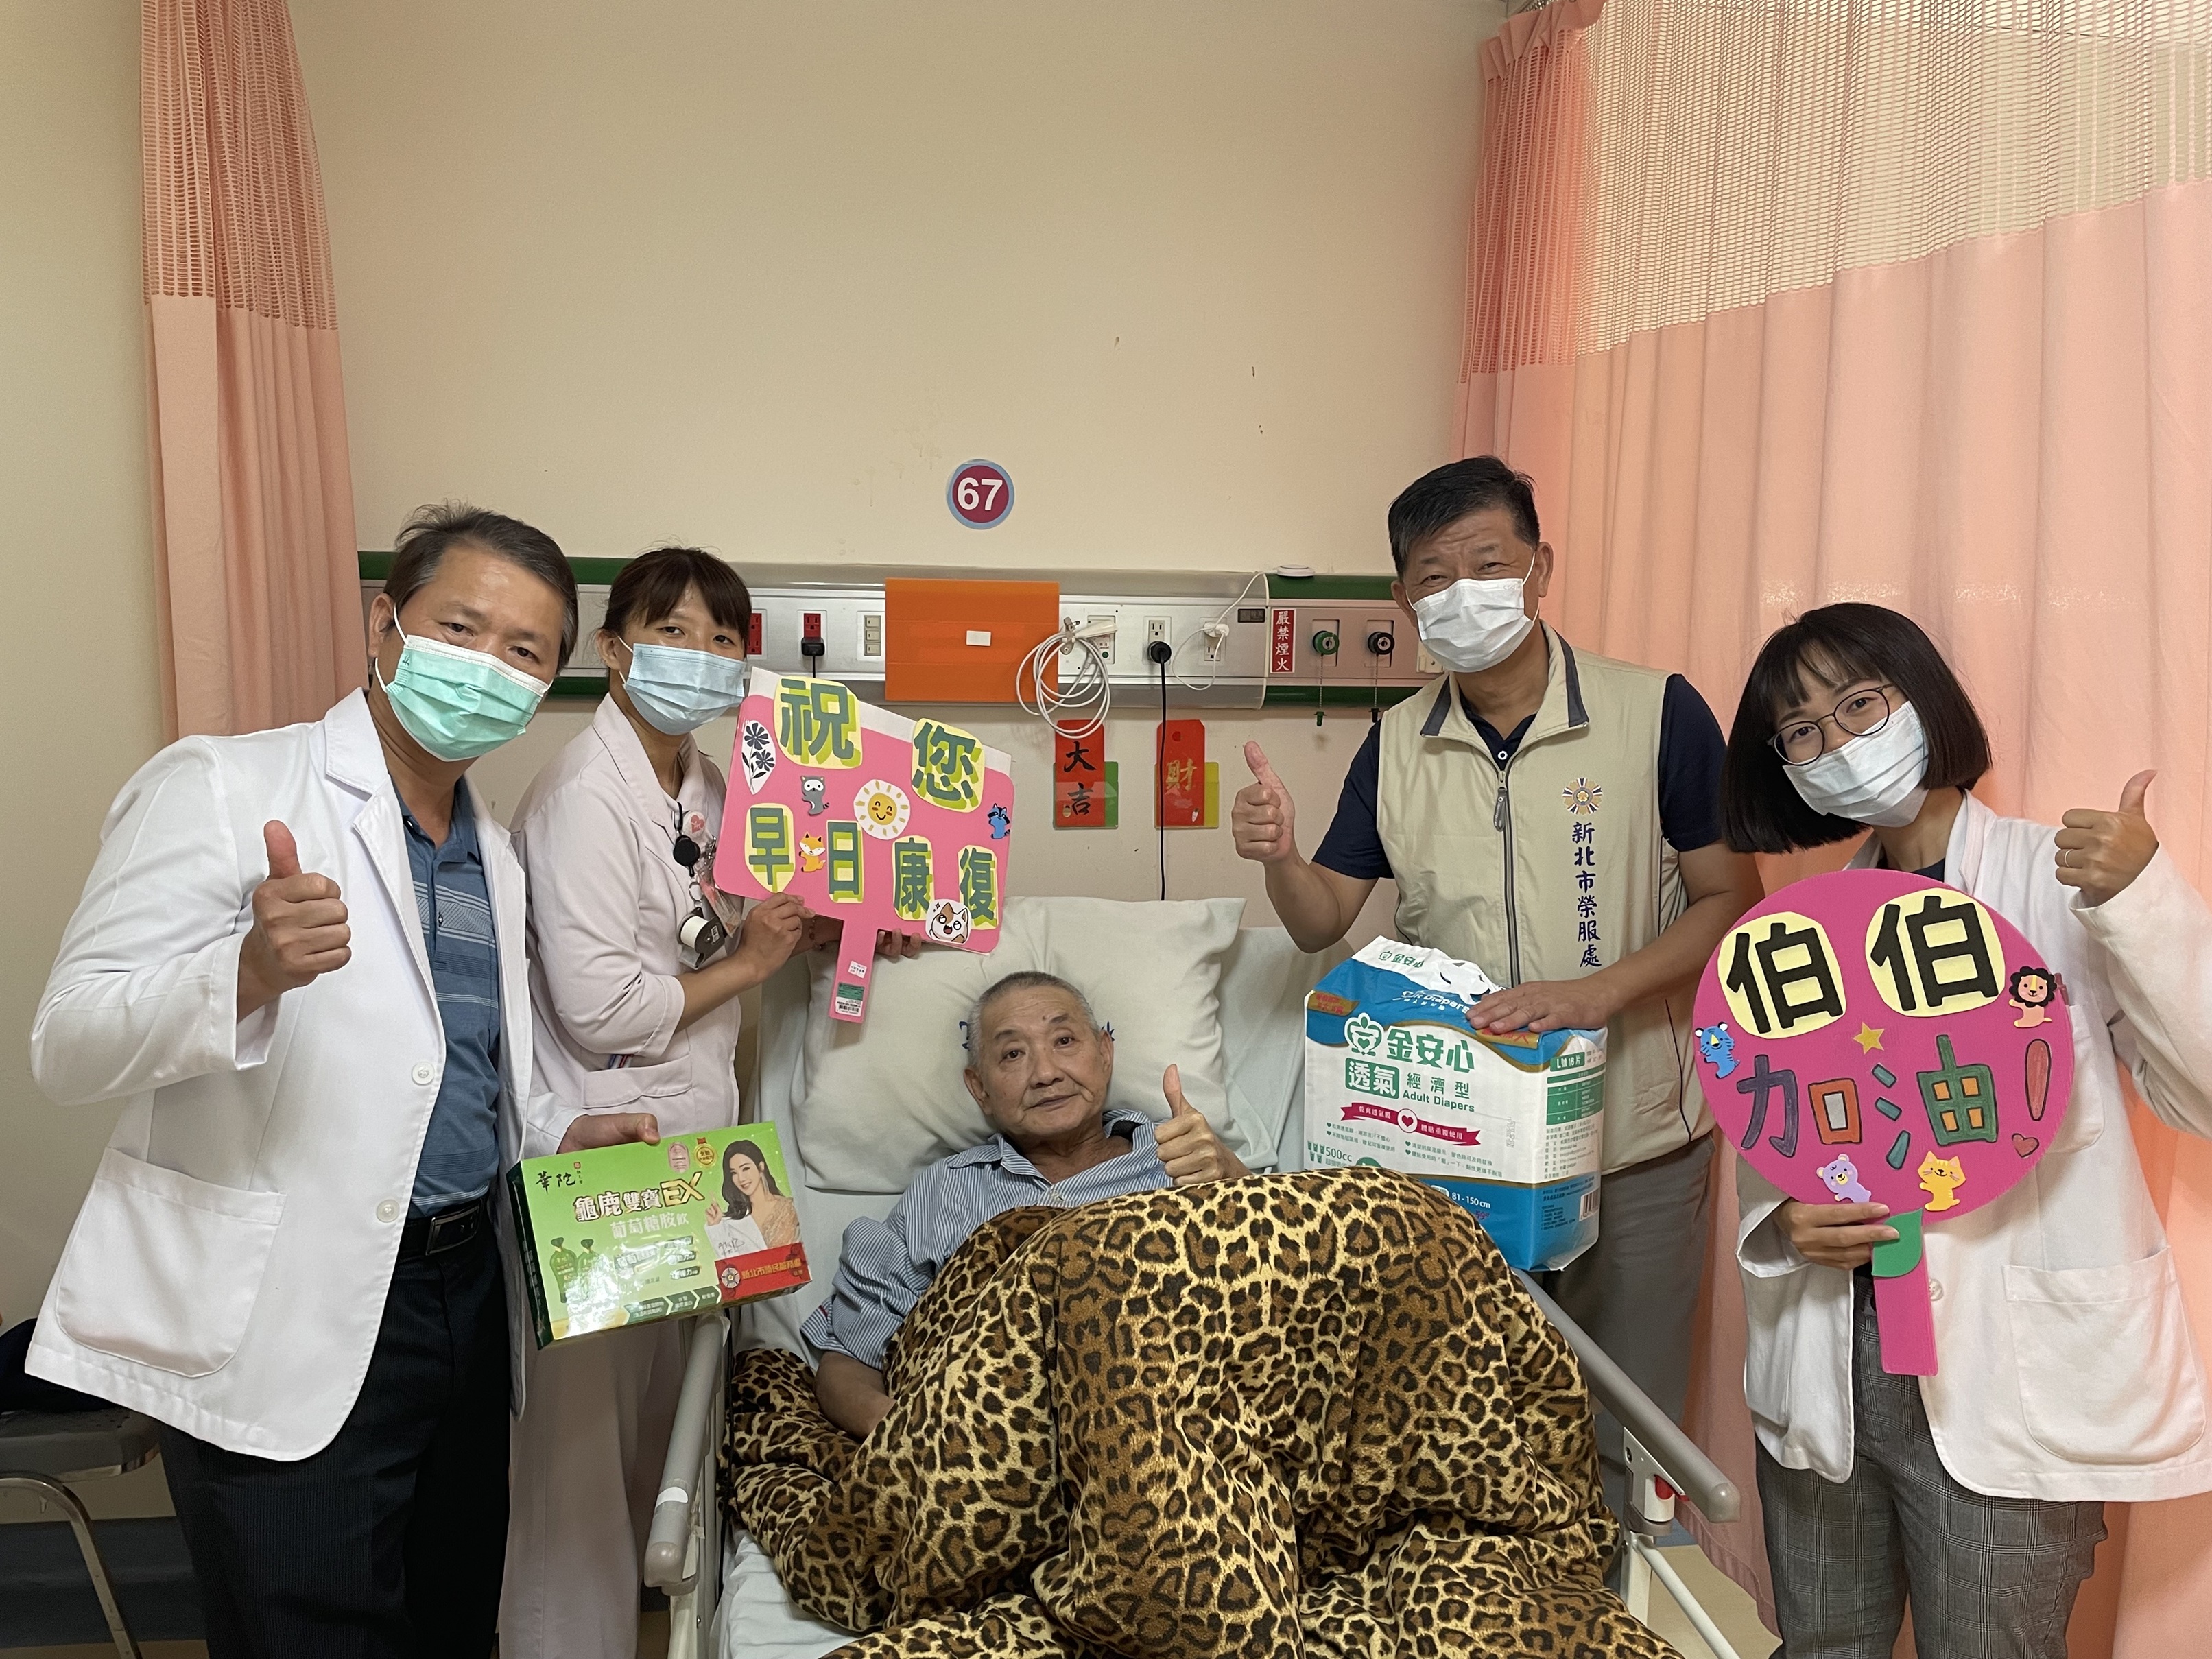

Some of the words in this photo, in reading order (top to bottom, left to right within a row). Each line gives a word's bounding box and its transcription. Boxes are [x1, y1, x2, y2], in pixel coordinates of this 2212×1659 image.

[958, 477, 1003, 510] 67
[1275, 610, 1291, 671] 嚴禁煙火
[779, 678, 976, 802] 祝您
[1063, 741, 1097, 815] 大吉
[1166, 758, 1198, 791] 財
[749, 807, 995, 922] 早日康復
[1572, 821, 1602, 968] 新北市榮服處
[1726, 895, 2000, 1034] 伯伯
[1387, 1028, 1475, 1073] 金安心
[1348, 1060, 1396, 1096] 透氣
[1406, 1071, 1470, 1099] 經濟型
[1403, 1090, 1429, 1103] Adult
[1434, 1095, 1475, 1112] Diapers
[1326, 1147, 1353, 1162] 500cc
